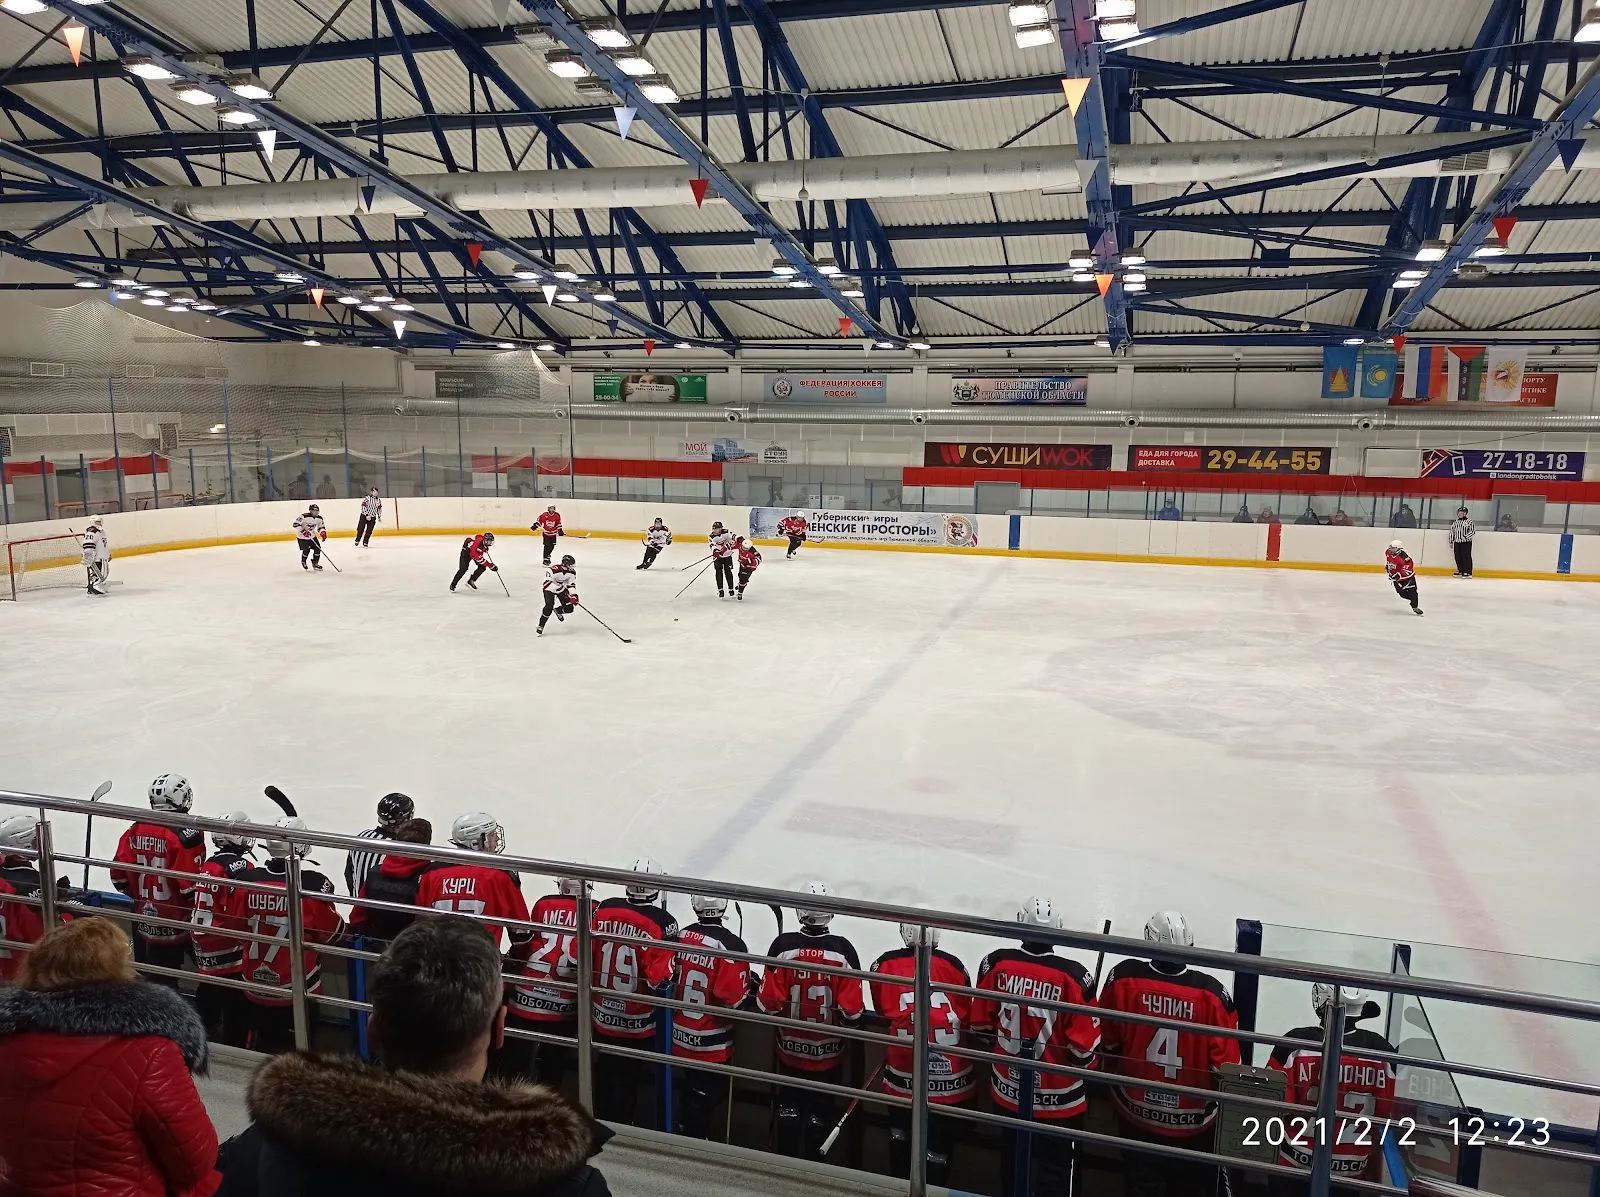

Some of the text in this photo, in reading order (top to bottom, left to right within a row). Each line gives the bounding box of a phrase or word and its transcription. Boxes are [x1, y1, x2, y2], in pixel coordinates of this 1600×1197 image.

[800, 380, 882, 388] ФЕДЕРАЦИЯ ХОККЕЯ
[994, 381, 1073, 391] ПРАВИТЕЛЬСТВО
[824, 390, 857, 398] РОССИИ
[981, 390, 1085, 400] ТЮМЕНСКОЙ ОБЛАСТИ
[685, 442, 707, 451] МОЙ
[1207, 449, 1322, 471] 29-44-55
[1482, 452, 1568, 470] 27-18-18
[1497, 473, 1557, 481] londongradtobolsk
[873, 516, 898, 524] игры
[442, 878, 476, 895] КУРЦ
[705, 909, 716, 917] 26
[247, 914, 290, 963] 17
[686, 930, 704, 941] STOP
[799, 948, 823, 957] STOP
[600, 942, 639, 993] 19
[997, 972, 1062, 1002] СМИРНОВ
[516, 992, 573, 1012] ТОБОЛЬСК
[790, 984, 833, 1026] 13
[1142, 993, 1194, 1020] ЧУПИН
[594, 1009, 642, 1028] ОБОЛЬСК
[672, 1028, 702, 1046] ОЛЬСК
[998, 1001, 1058, 1060] 97
[782, 1040, 839, 1056] ТОБОЛЬСК
[1146, 1027, 1183, 1080] 4
[904, 1077, 967, 1091] ТОЛЬСК
[1128, 1101, 1196, 1125] ТОБОЛЬСК
[1293, 1148, 1368, 1171] ТОЛЬСК
